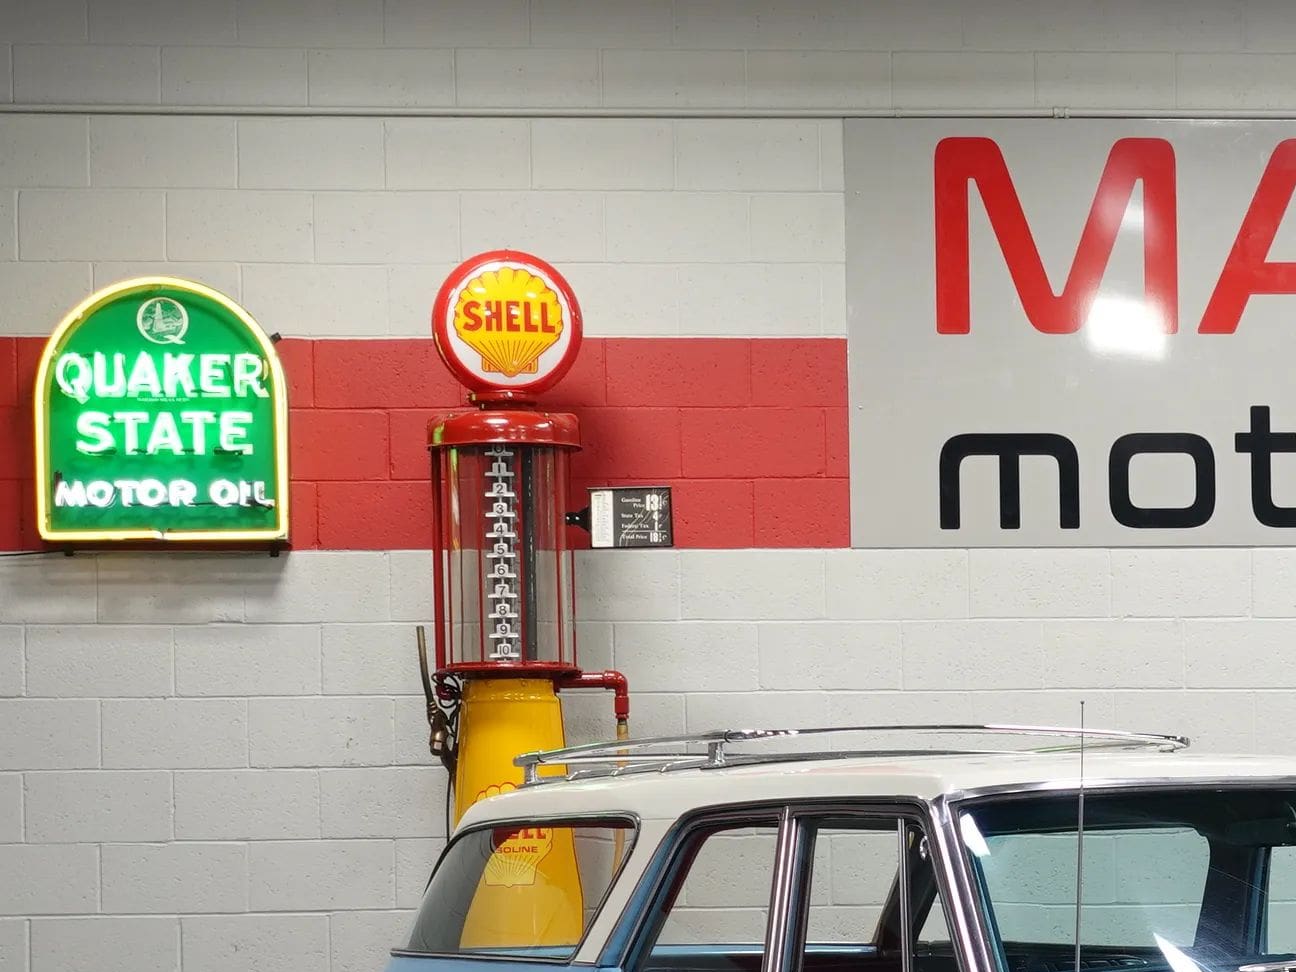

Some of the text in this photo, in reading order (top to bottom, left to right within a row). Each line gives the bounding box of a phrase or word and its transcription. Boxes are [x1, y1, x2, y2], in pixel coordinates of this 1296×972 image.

[463, 300, 556, 333] SHELL
[55, 351, 269, 404] QUAKER
[75, 411, 254, 455] STATE
[55, 478, 275, 508] MOTOR OIL
[496, 484, 504, 494] 2
[496, 504, 504, 514] 3
[495, 524, 504, 535] 4
[497, 544, 504, 555] 5
[498, 565, 506, 576] 6
[499, 585, 506, 596] 7
[500, 605, 508, 616] 8
[500, 624, 508, 635] 9
[500, 647, 510, 655] 10
